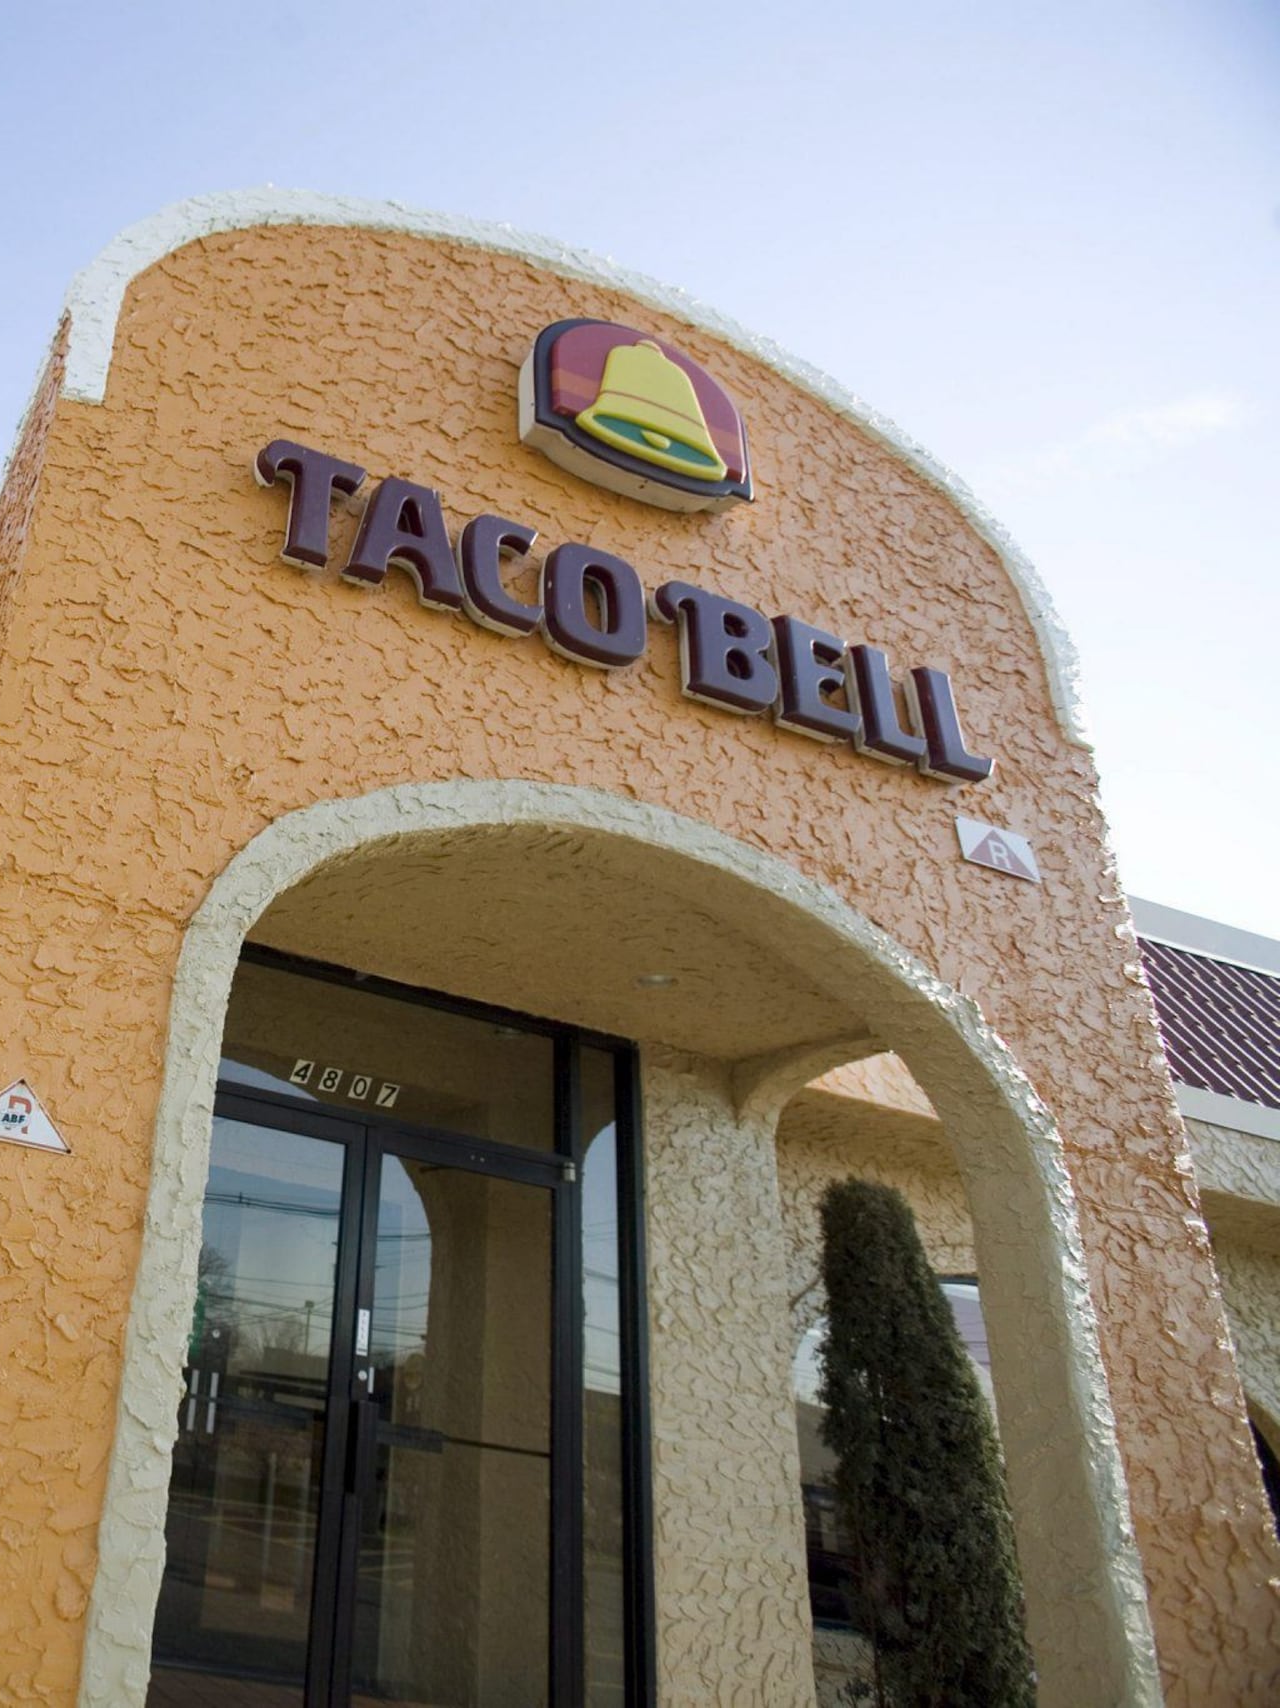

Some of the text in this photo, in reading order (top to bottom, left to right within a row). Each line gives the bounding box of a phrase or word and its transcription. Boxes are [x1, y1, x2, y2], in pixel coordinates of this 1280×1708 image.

[254, 438, 996, 786] TACO BELL
[986, 839, 1014, 870] R
[293, 1062, 398, 1105] 4807
[1, 1113, 26, 1124] ABF
